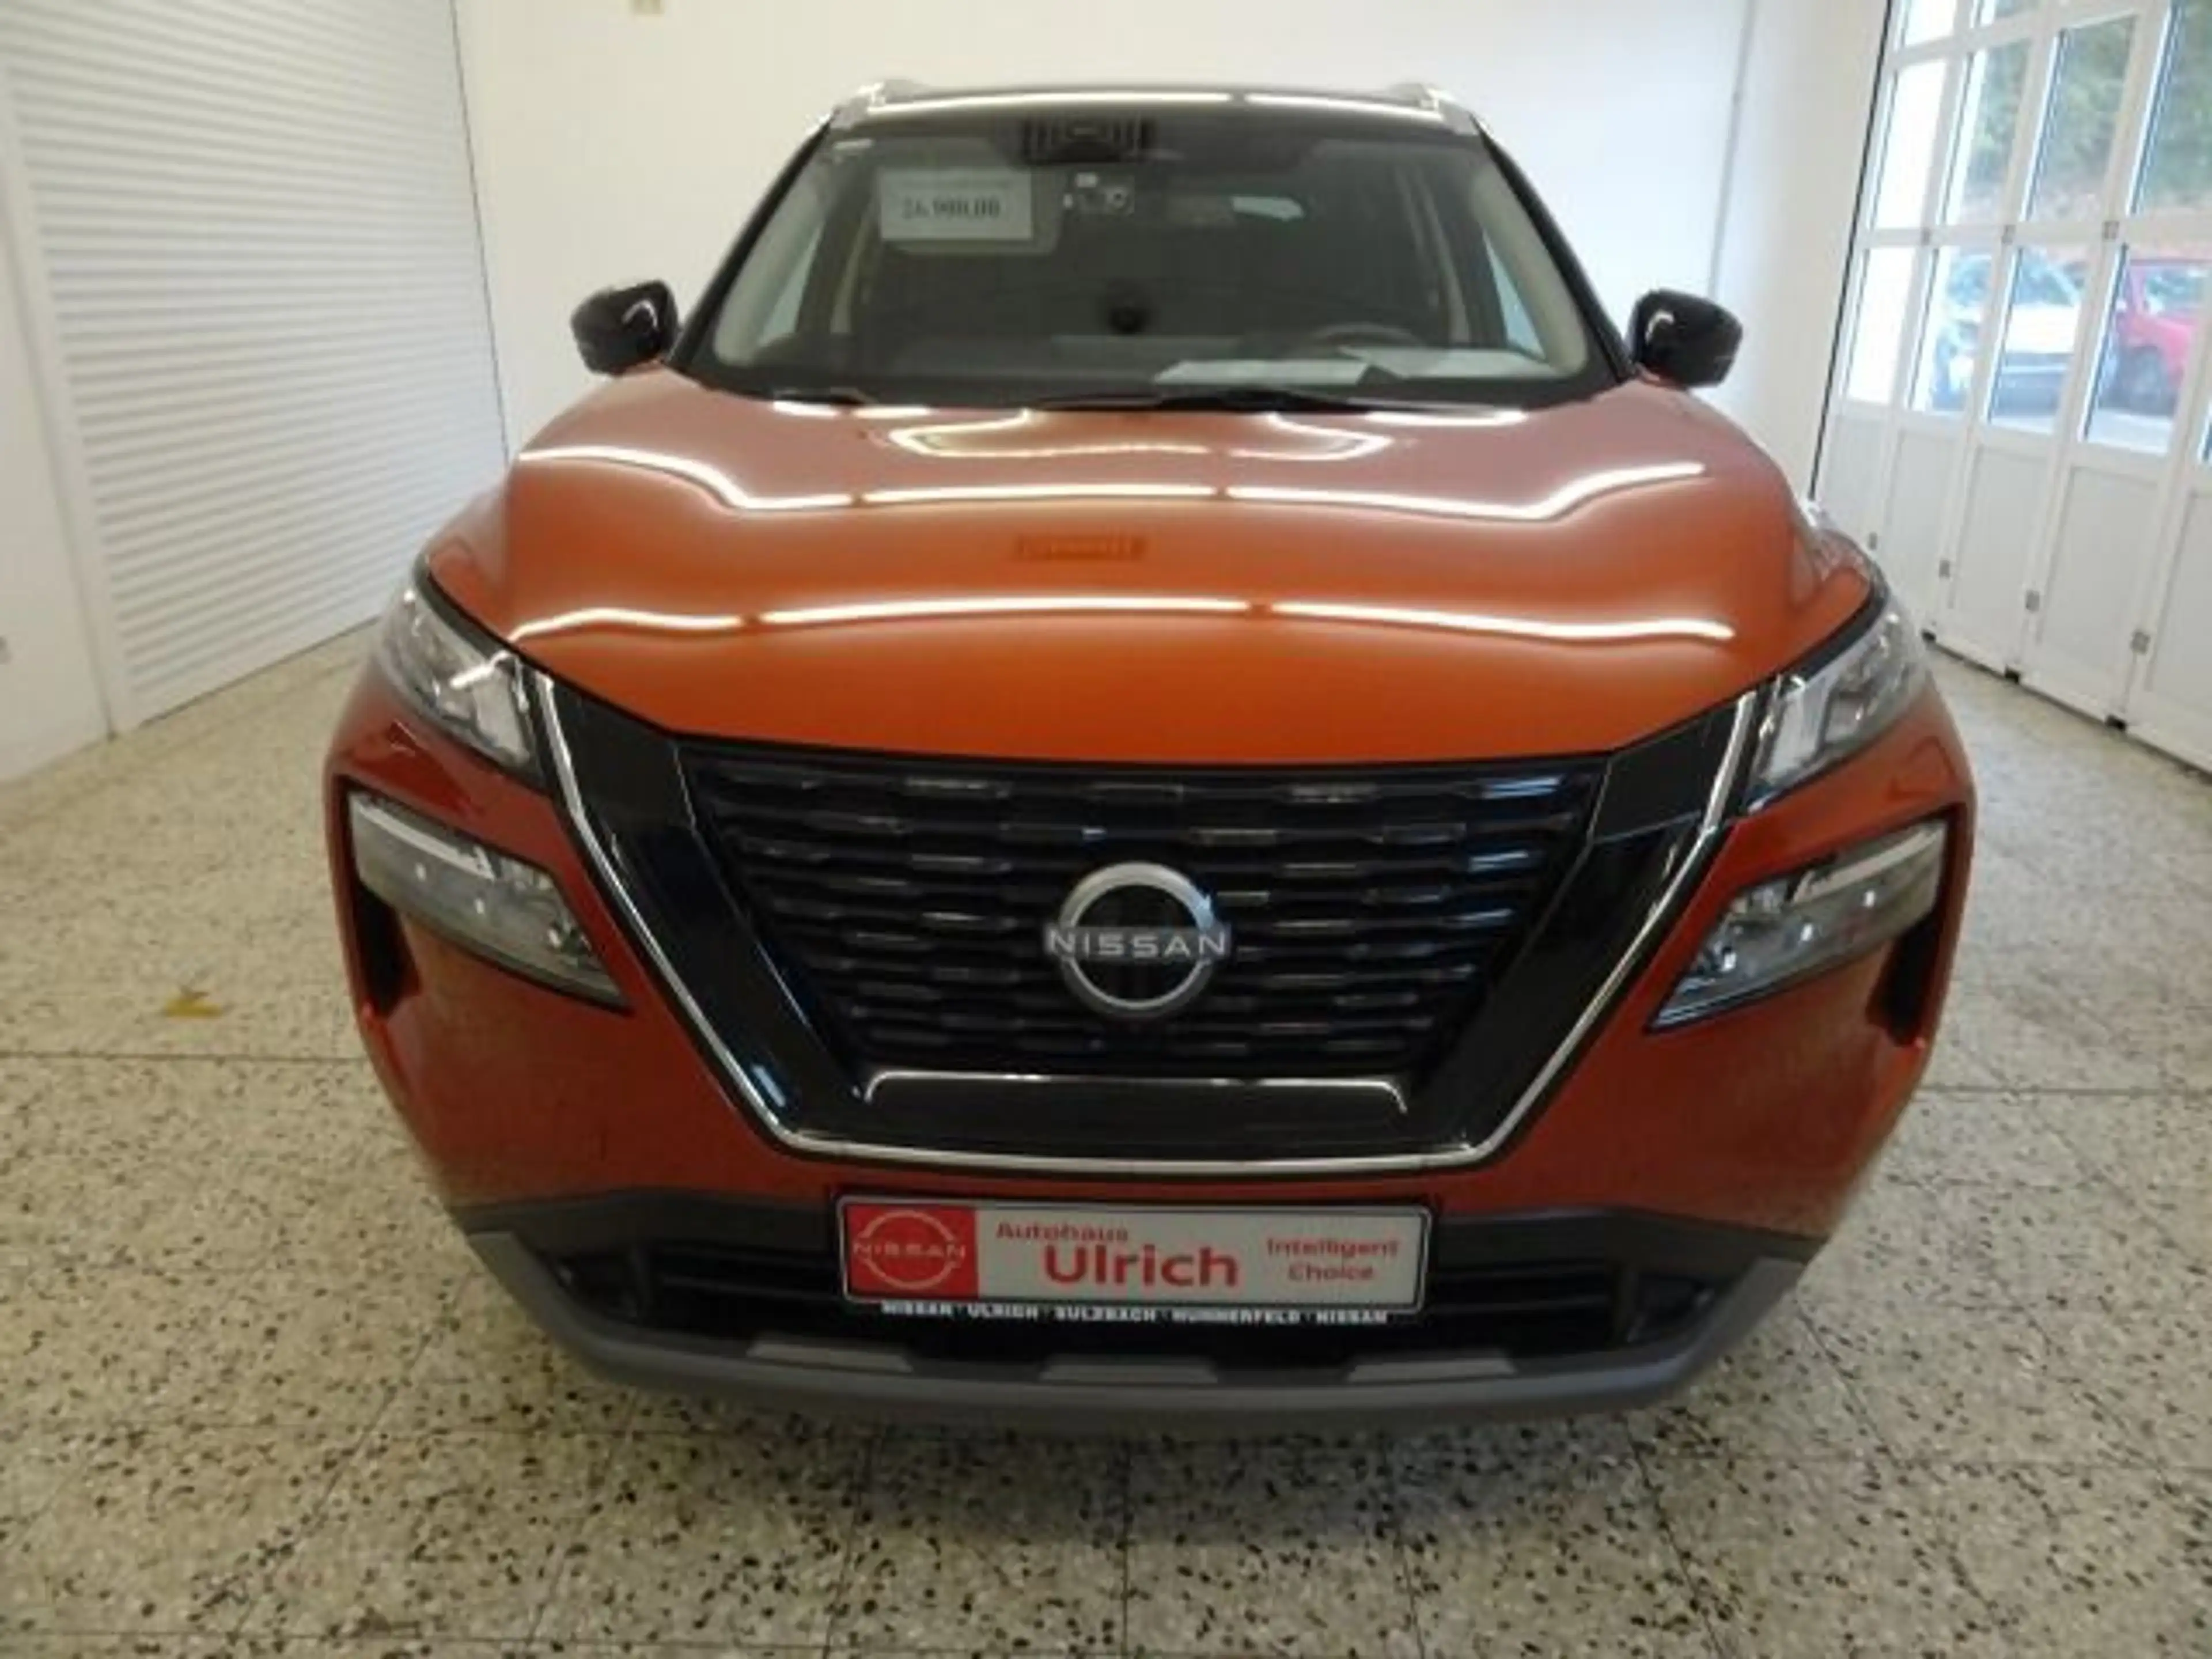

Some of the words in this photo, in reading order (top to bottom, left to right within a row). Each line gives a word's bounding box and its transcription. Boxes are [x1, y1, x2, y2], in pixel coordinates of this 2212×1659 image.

[1047, 929, 1227, 957] NISSAN
[997, 1222, 1128, 1241] Autohaus
[853, 1241, 965, 1259] NISSAN
[1267, 1238, 1397, 1258] Intelligent
[1045, 1243, 1238, 1287] Ulrich
[1289, 1265, 1373, 1280] Choice
[881, 1300, 952, 1315] NISSAN
[967, 1302, 1037, 1318] ULRICH
[1055, 1306, 1155, 1321] SULZBACH
